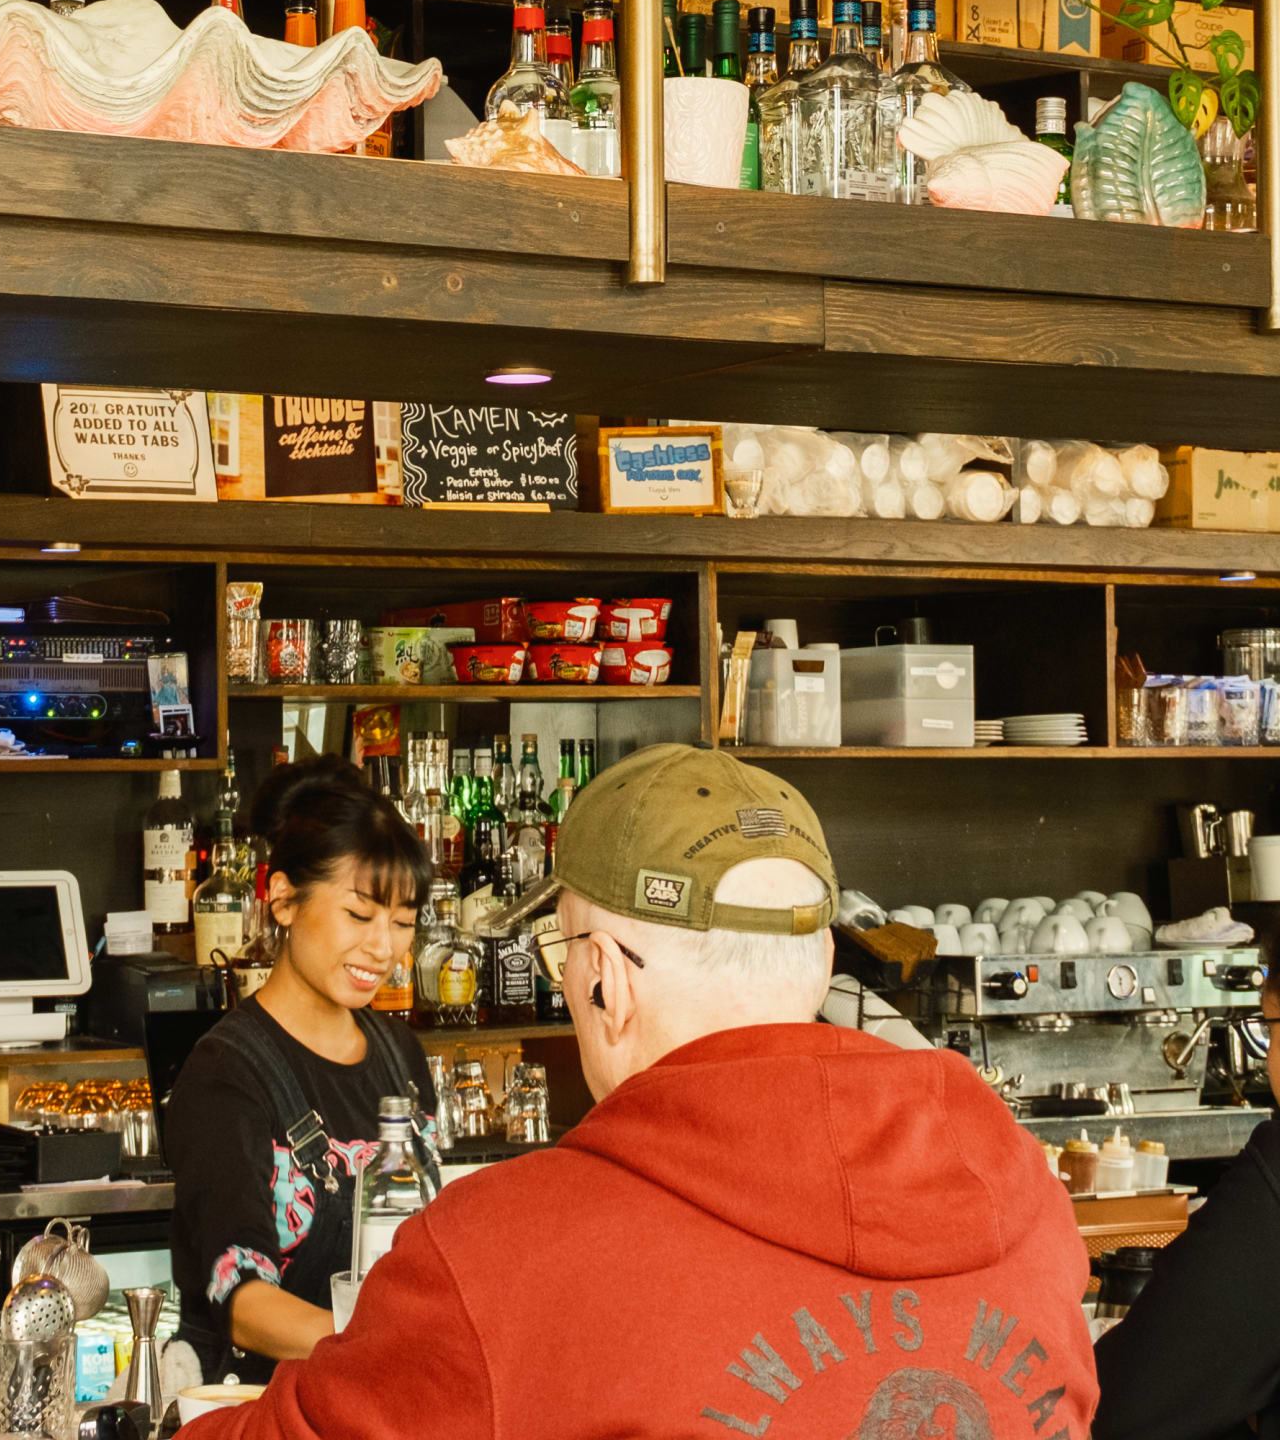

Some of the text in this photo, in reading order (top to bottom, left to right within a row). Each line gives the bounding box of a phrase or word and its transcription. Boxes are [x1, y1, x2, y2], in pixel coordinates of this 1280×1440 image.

[70, 402, 177, 420] 20% GRATUITY
[73, 417, 179, 434] ADDED TO ALL
[75, 432, 180, 449] WALKED TABS
[279, 426, 344, 447] caffeine
[112, 452, 147, 462] THANKS
[289, 440, 355, 460] cocktails
[430, 440, 477, 468] Veggie
[486, 446, 499, 456] or
[469, 467, 499, 478] Extras
[446, 477, 480, 489] Peanut
[483, 477, 514, 488] Butter
[683, 823, 739, 860] CREATIVE
[650, 878, 681, 892] ALL
[645, 888, 680, 903] CAPS
[701, 1288, 1072, 1440] LWAYS WEA
